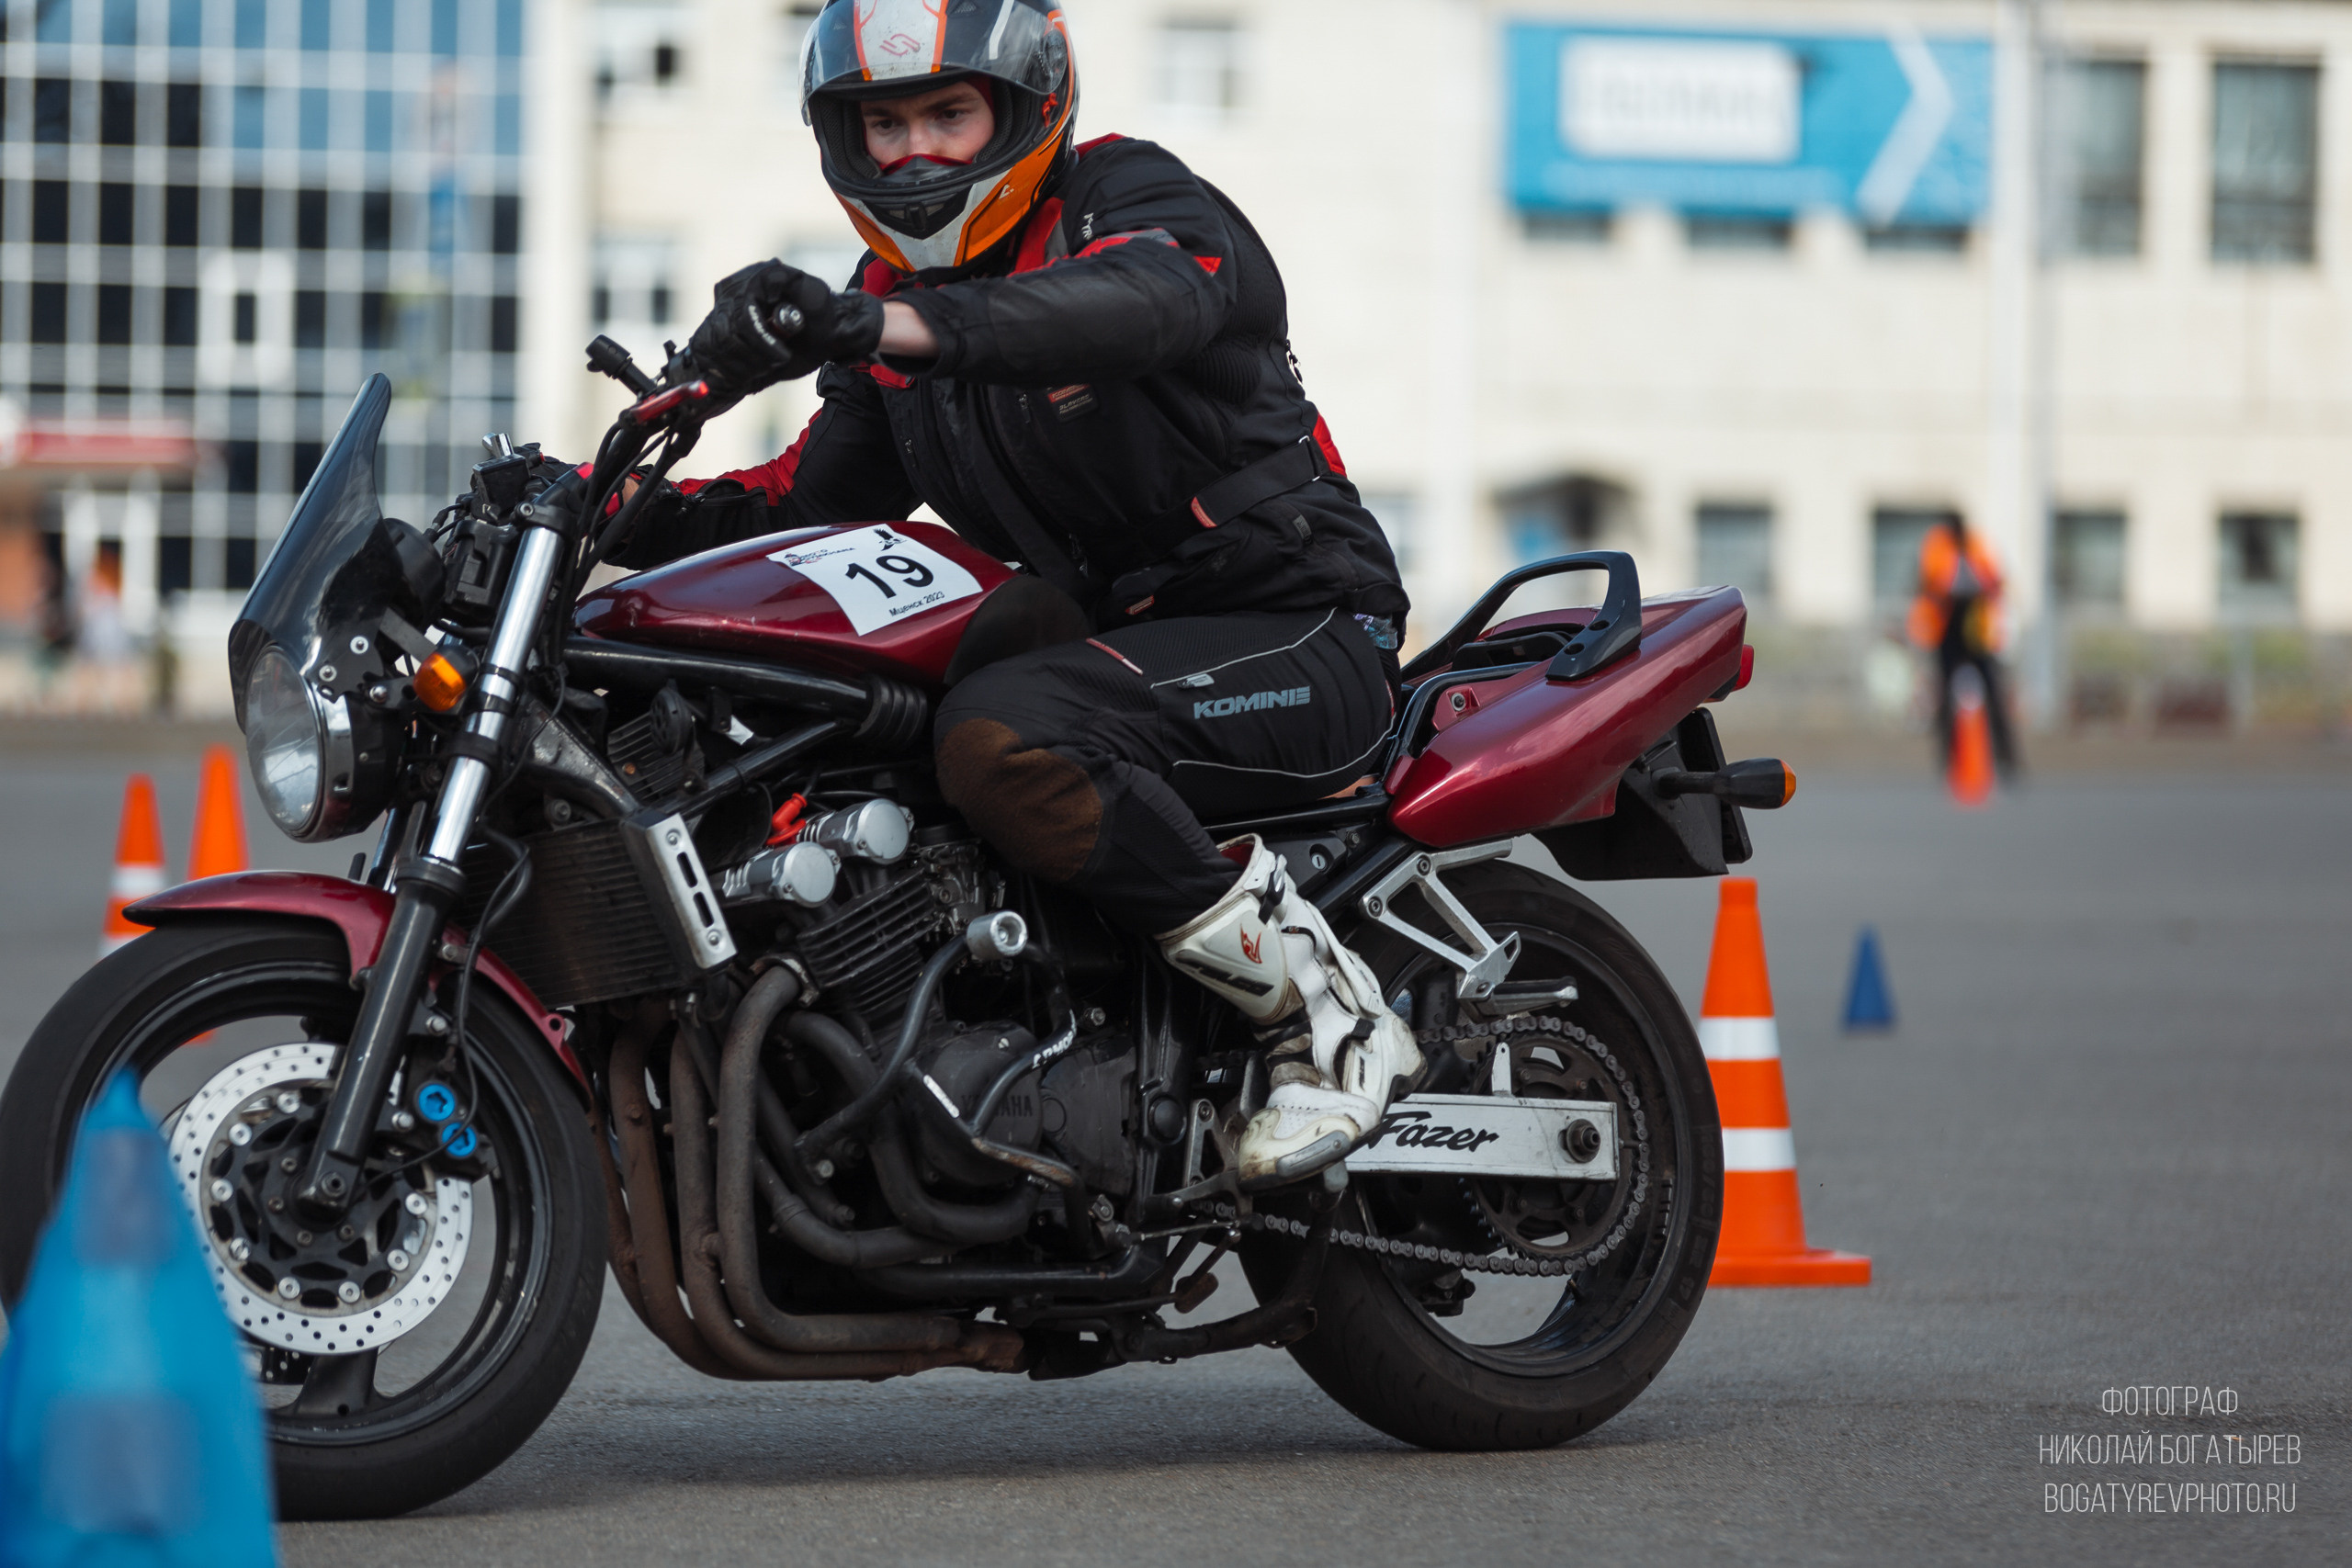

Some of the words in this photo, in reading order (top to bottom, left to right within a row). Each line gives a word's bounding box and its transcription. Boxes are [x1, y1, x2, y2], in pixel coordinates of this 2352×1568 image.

[845, 555, 933, 599] 19
[888, 600, 924, 616] Мценск
[923, 591, 945, 604] 2023
[1193, 685, 1311, 719] KOMINE
[960, 1094, 1033, 1117] YAHA
[1368, 1111, 1499, 1153] Fazer
